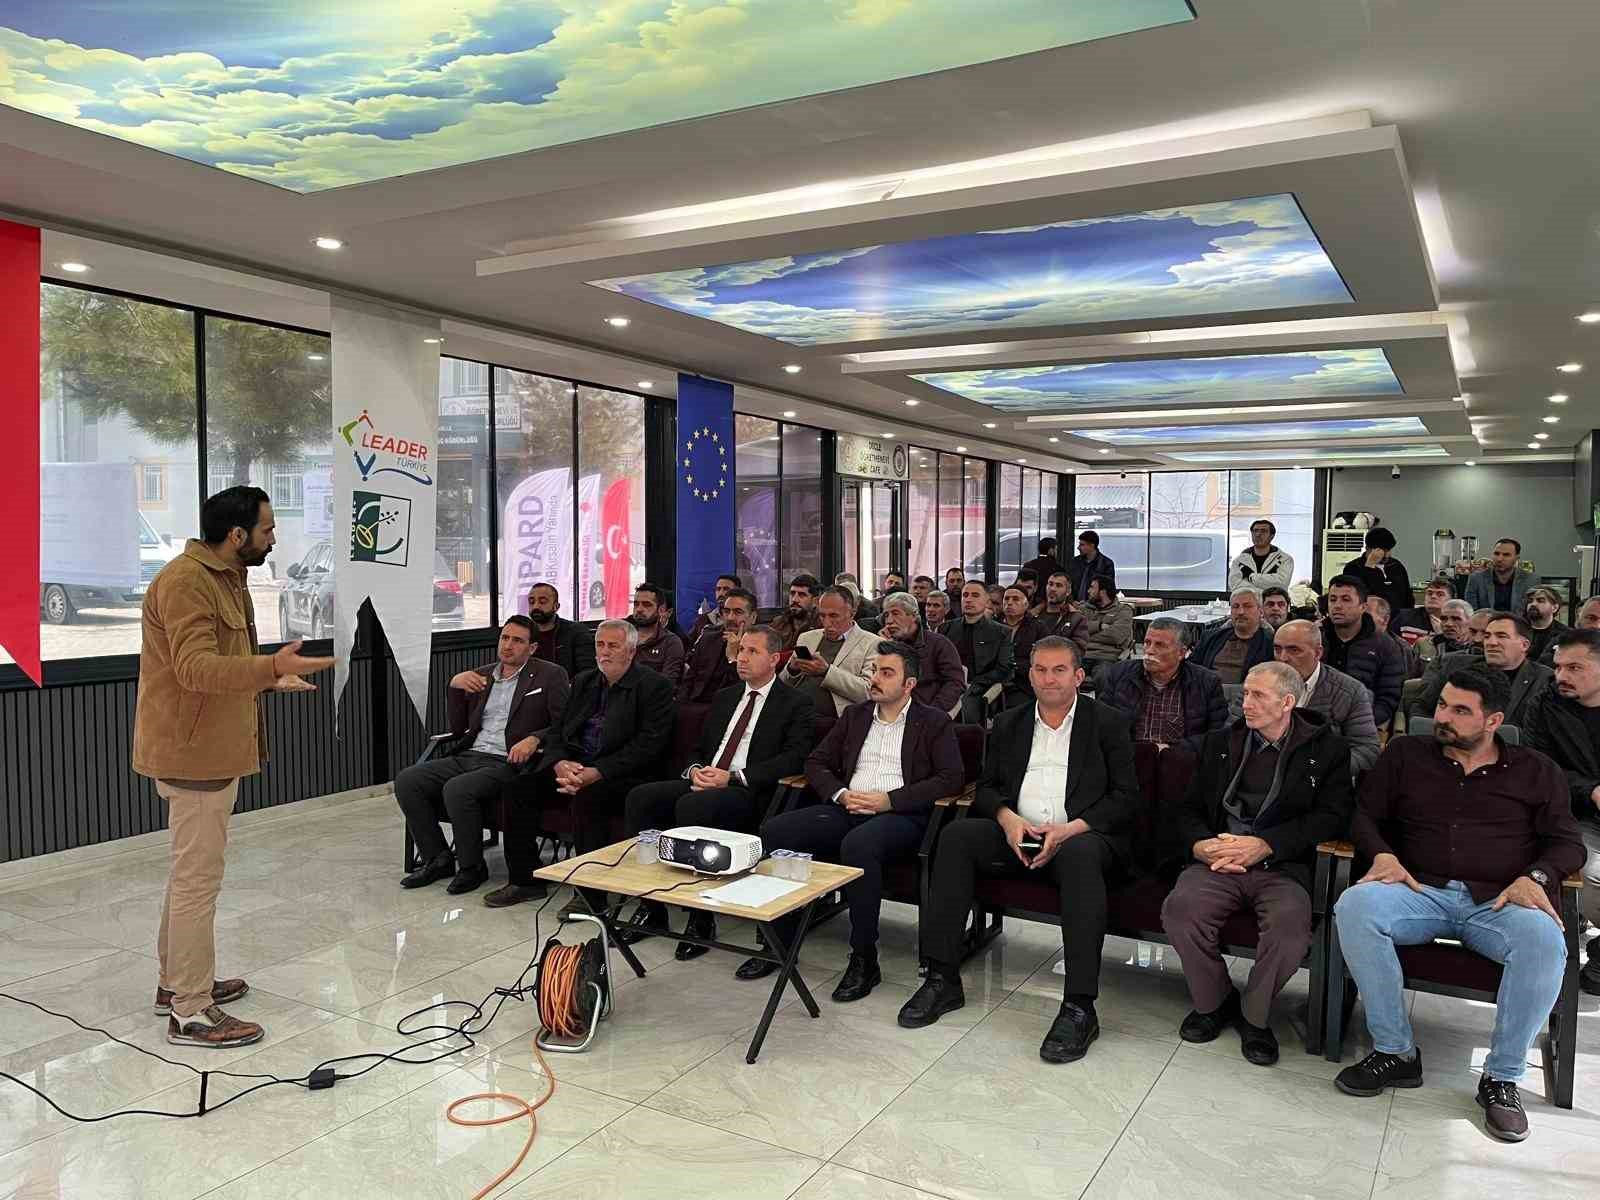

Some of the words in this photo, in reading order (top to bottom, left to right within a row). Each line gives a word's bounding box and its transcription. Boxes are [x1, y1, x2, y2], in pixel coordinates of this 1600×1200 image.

[361, 432, 428, 461] LEADER
[396, 456, 428, 473] TÜRKİYE
[517, 495, 544, 588] IPARD
